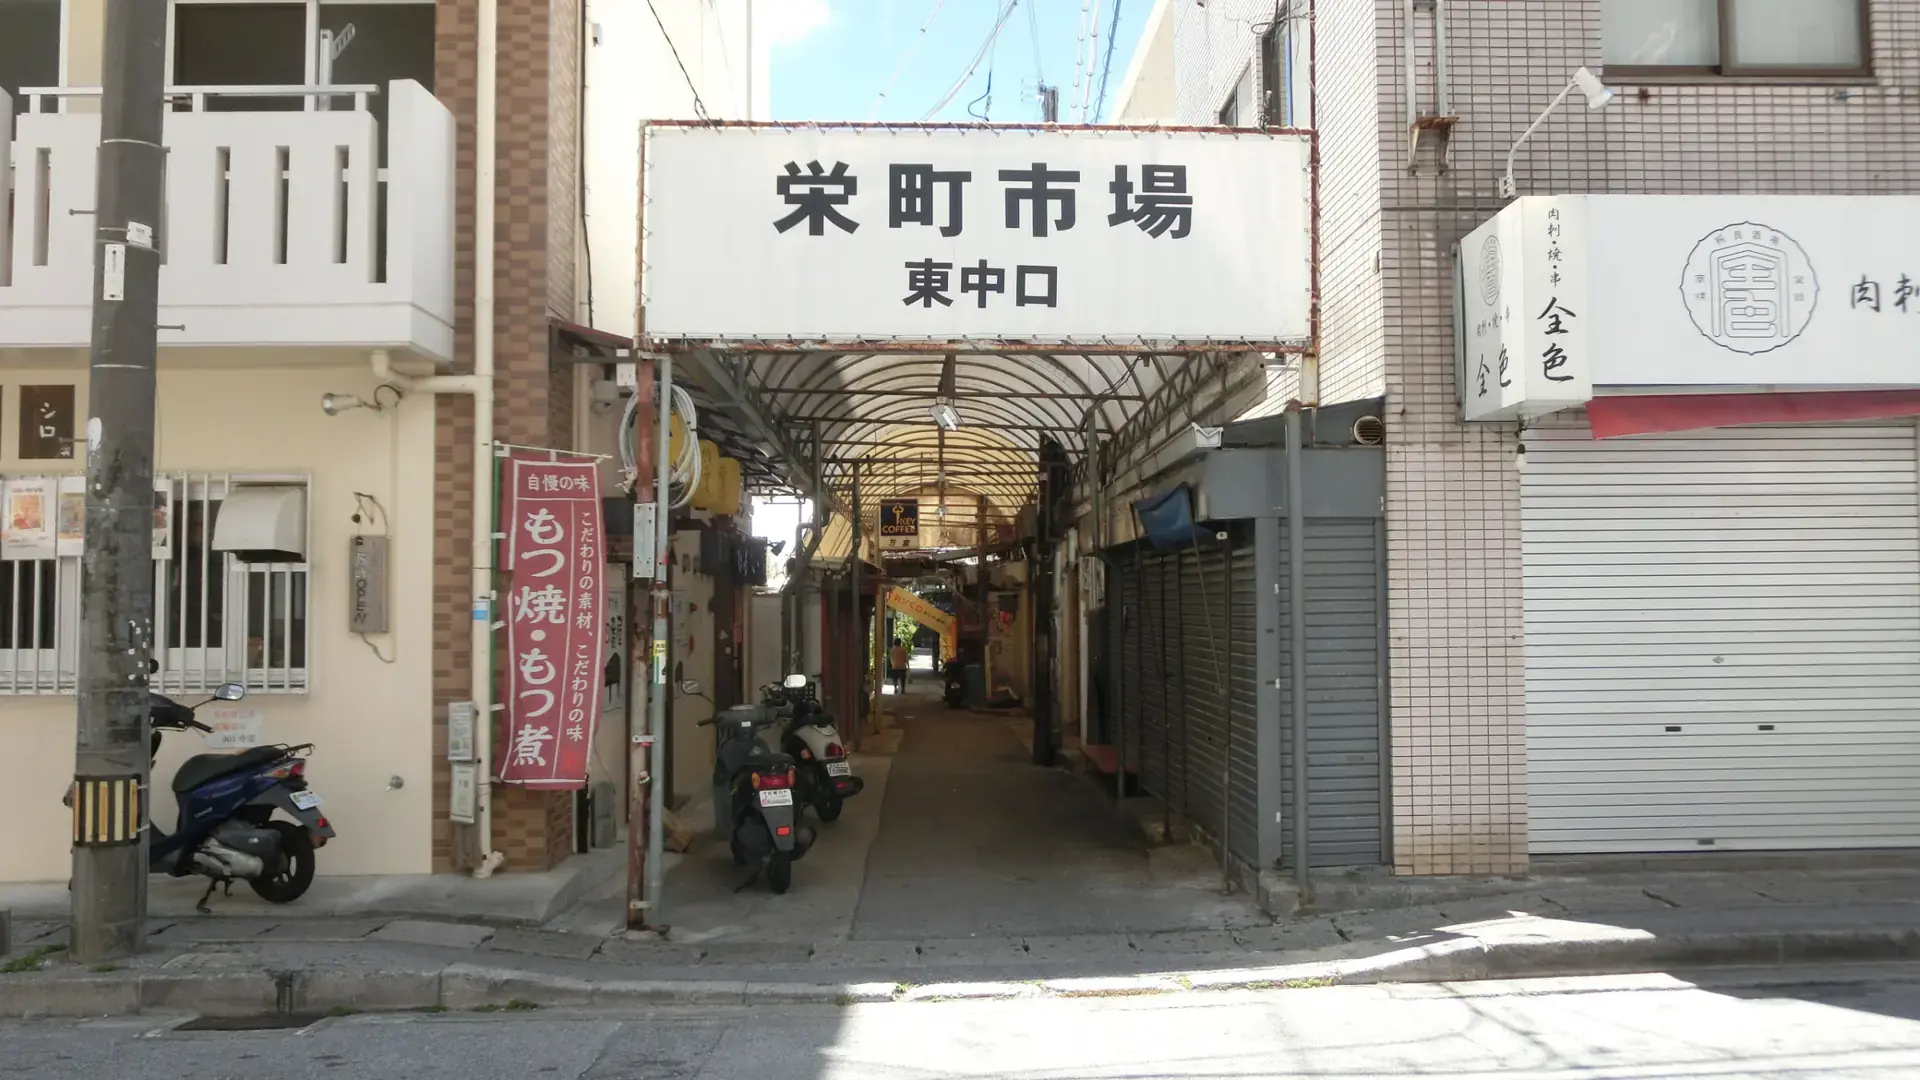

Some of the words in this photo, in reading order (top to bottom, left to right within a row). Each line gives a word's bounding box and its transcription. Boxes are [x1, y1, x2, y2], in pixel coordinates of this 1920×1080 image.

[773, 160, 1194, 239] 栄町市場
[902, 258, 1058, 308] 東中口
[1536, 296, 1577, 384] 全色
[39, 402, 57, 439] シロ
[528, 473, 590, 492] 自慢の味
